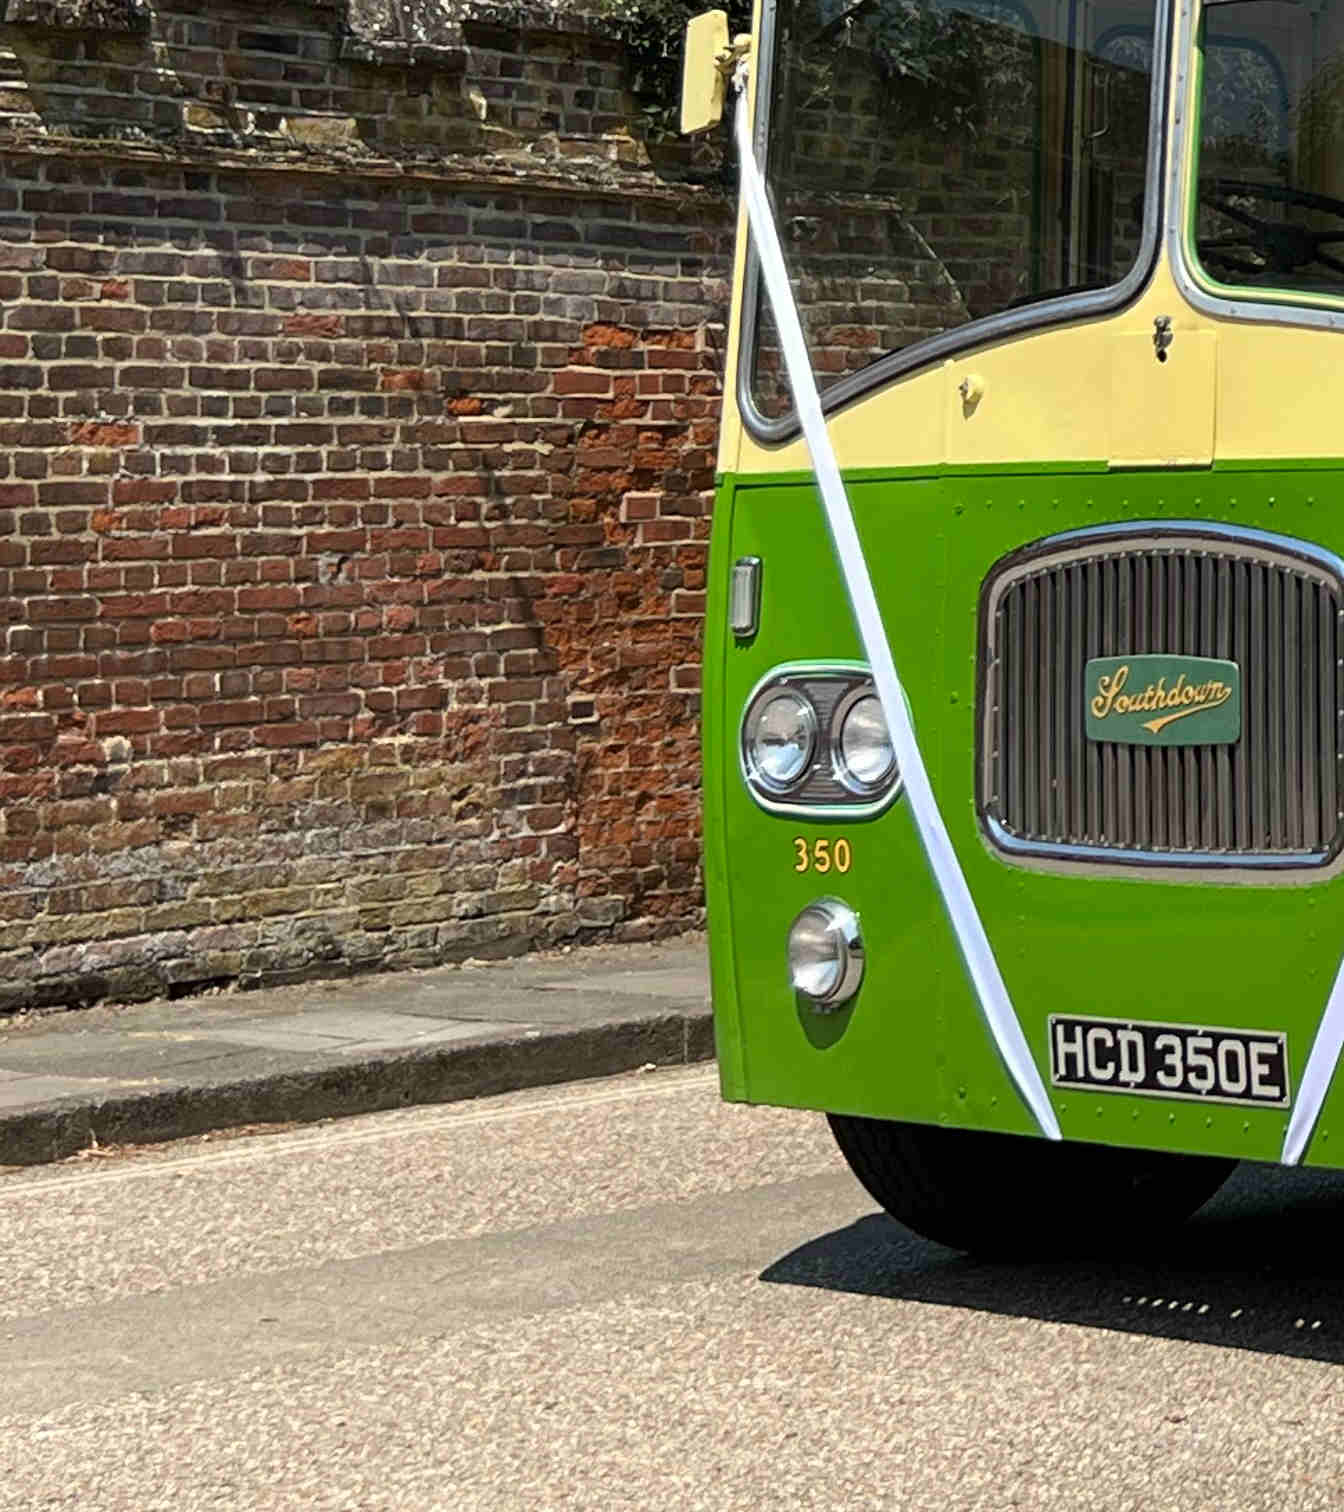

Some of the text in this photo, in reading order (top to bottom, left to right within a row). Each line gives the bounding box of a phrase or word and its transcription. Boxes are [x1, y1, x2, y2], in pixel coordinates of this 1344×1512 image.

[1090, 664, 1233, 732] Southdown
[793, 837, 851, 873] 350
[1055, 1023, 1281, 1098] HCD 350E
